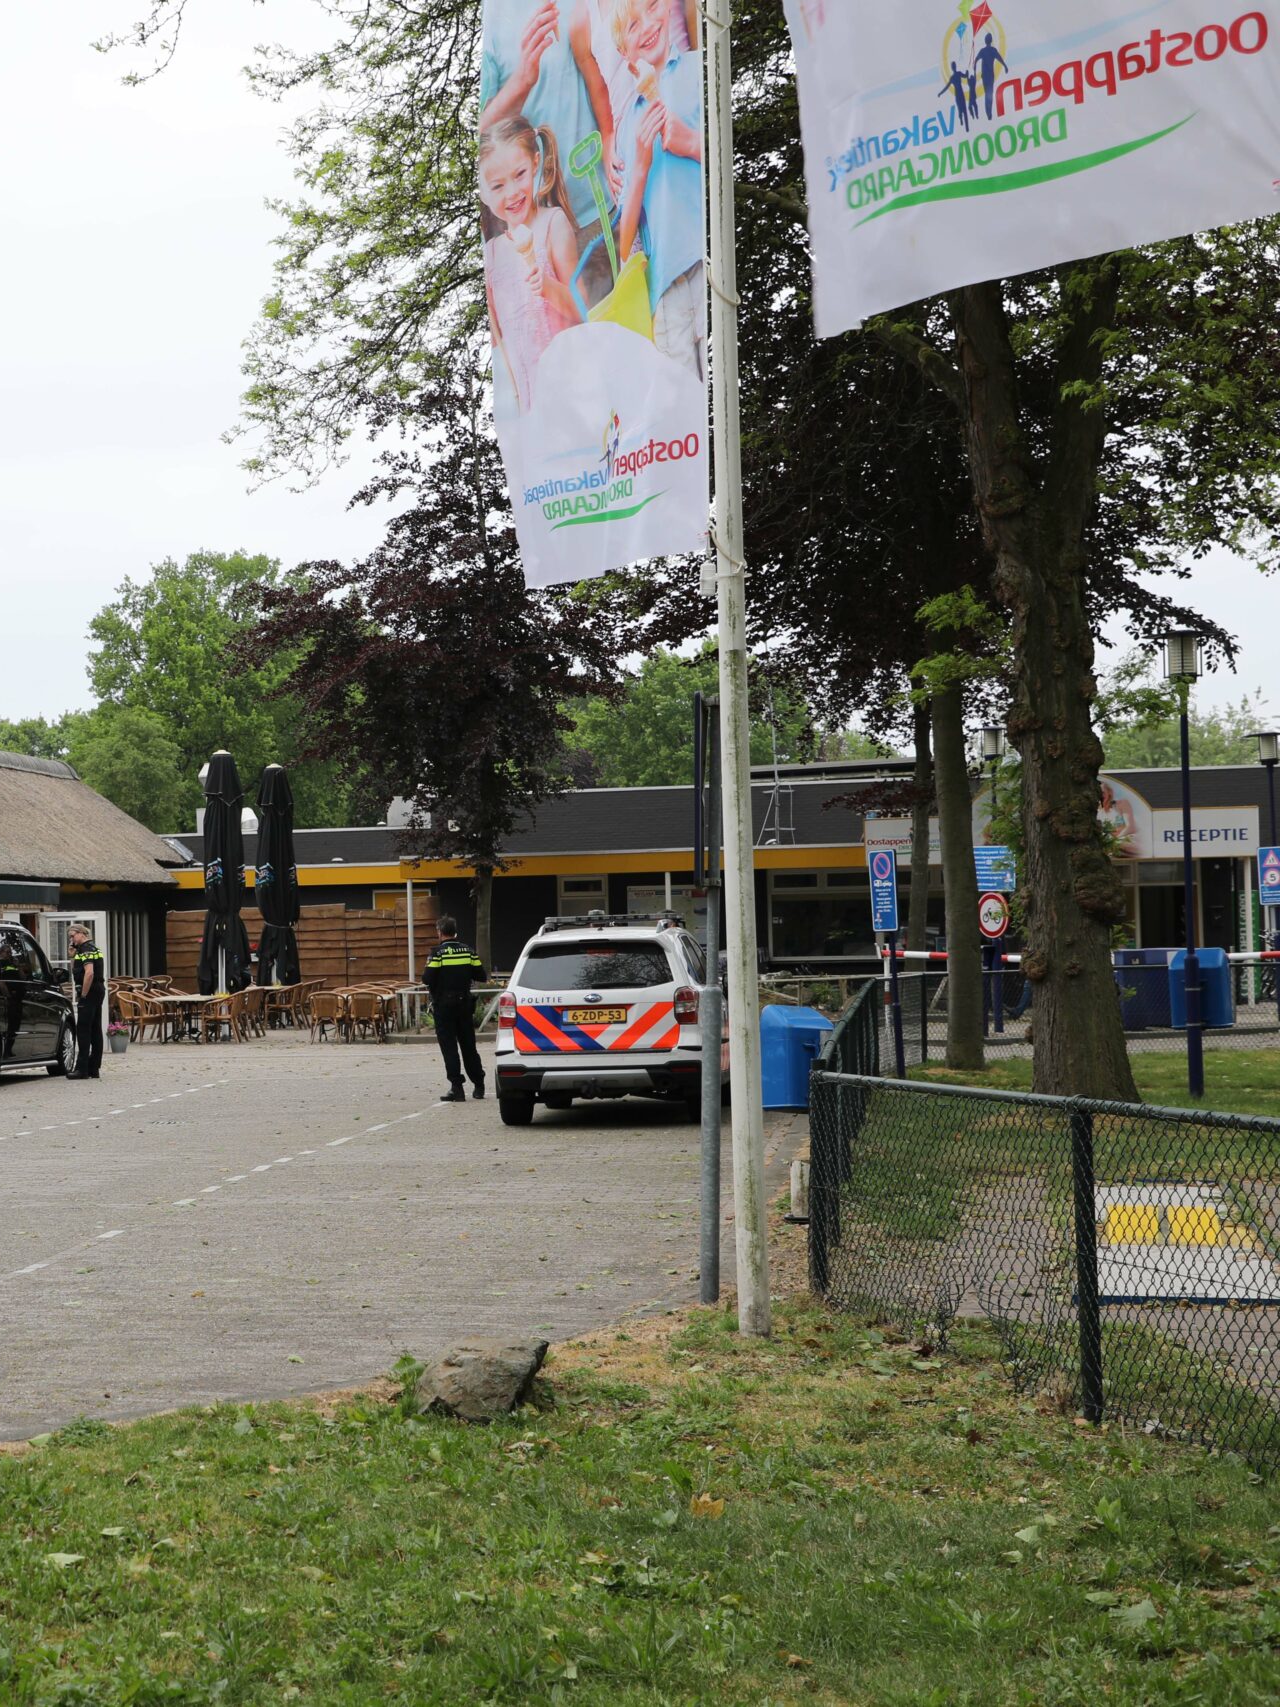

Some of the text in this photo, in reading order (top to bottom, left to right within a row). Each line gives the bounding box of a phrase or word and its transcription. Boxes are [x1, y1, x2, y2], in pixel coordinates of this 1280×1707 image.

[1163, 828, 1249, 842] RECEPTIE
[1269, 873, 1277, 882] 5
[521, 996, 563, 1004] POLITIE
[571, 1010, 622, 1021] 6-ZDP-53
